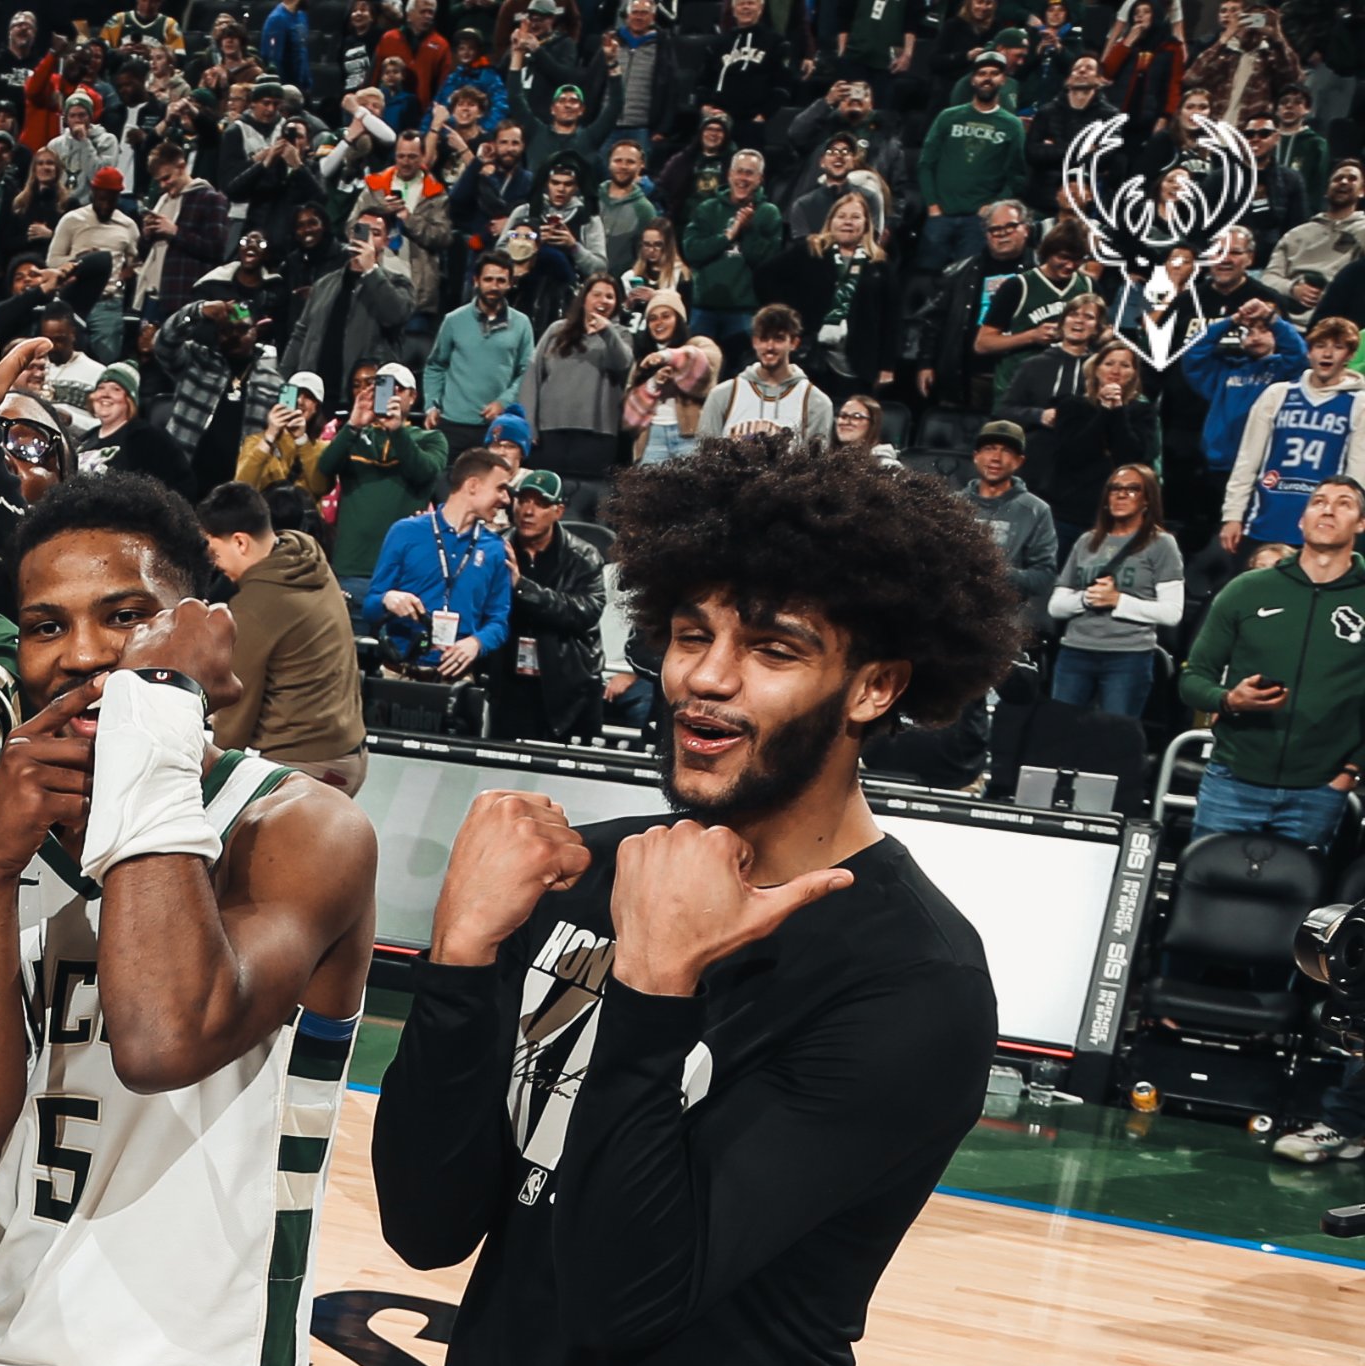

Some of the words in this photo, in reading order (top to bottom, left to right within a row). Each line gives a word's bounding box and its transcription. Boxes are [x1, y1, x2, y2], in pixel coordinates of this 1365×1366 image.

[951, 124, 1007, 145] BUCKS
[1276, 409, 1348, 434] HELLAS
[1281, 437, 1326, 469] 34
[1278, 480, 1318, 494] Euroba
[1075, 565, 1136, 589] BUS
[1124, 880, 1141, 933] SCIENCE
[532, 920, 617, 995] HON
[1100, 990, 1118, 1043] SCIENCE
[30, 1094, 103, 1229] 5
